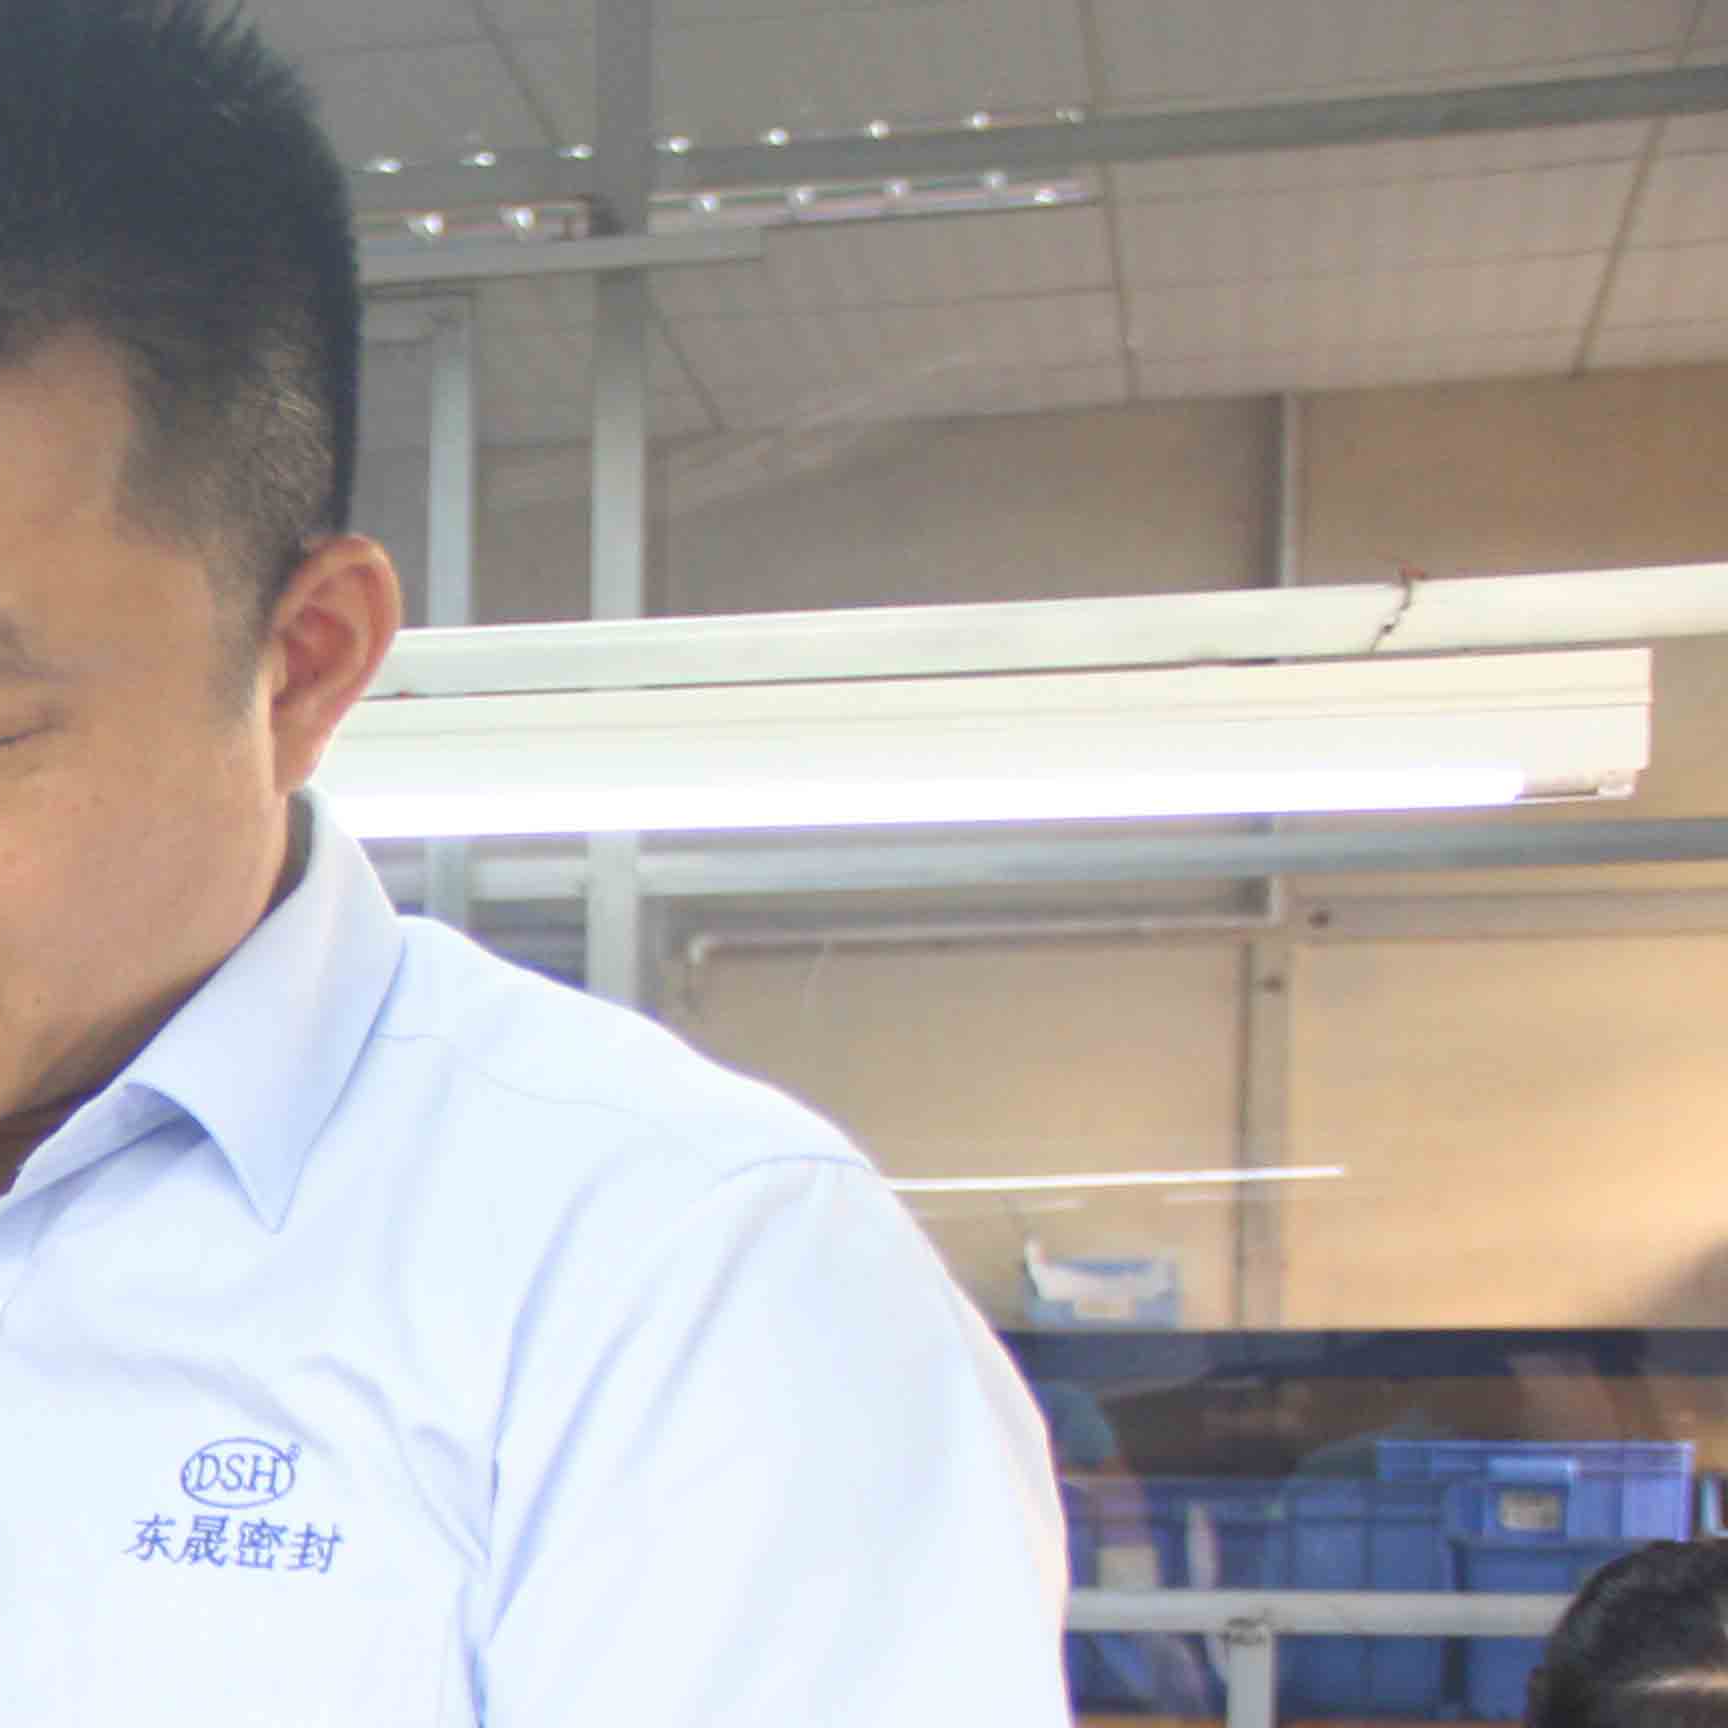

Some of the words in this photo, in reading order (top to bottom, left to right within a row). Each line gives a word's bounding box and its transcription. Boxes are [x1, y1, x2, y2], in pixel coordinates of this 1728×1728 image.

[193, 1453, 279, 1494] DSH
[122, 1512, 346, 1575] 东晟密封
